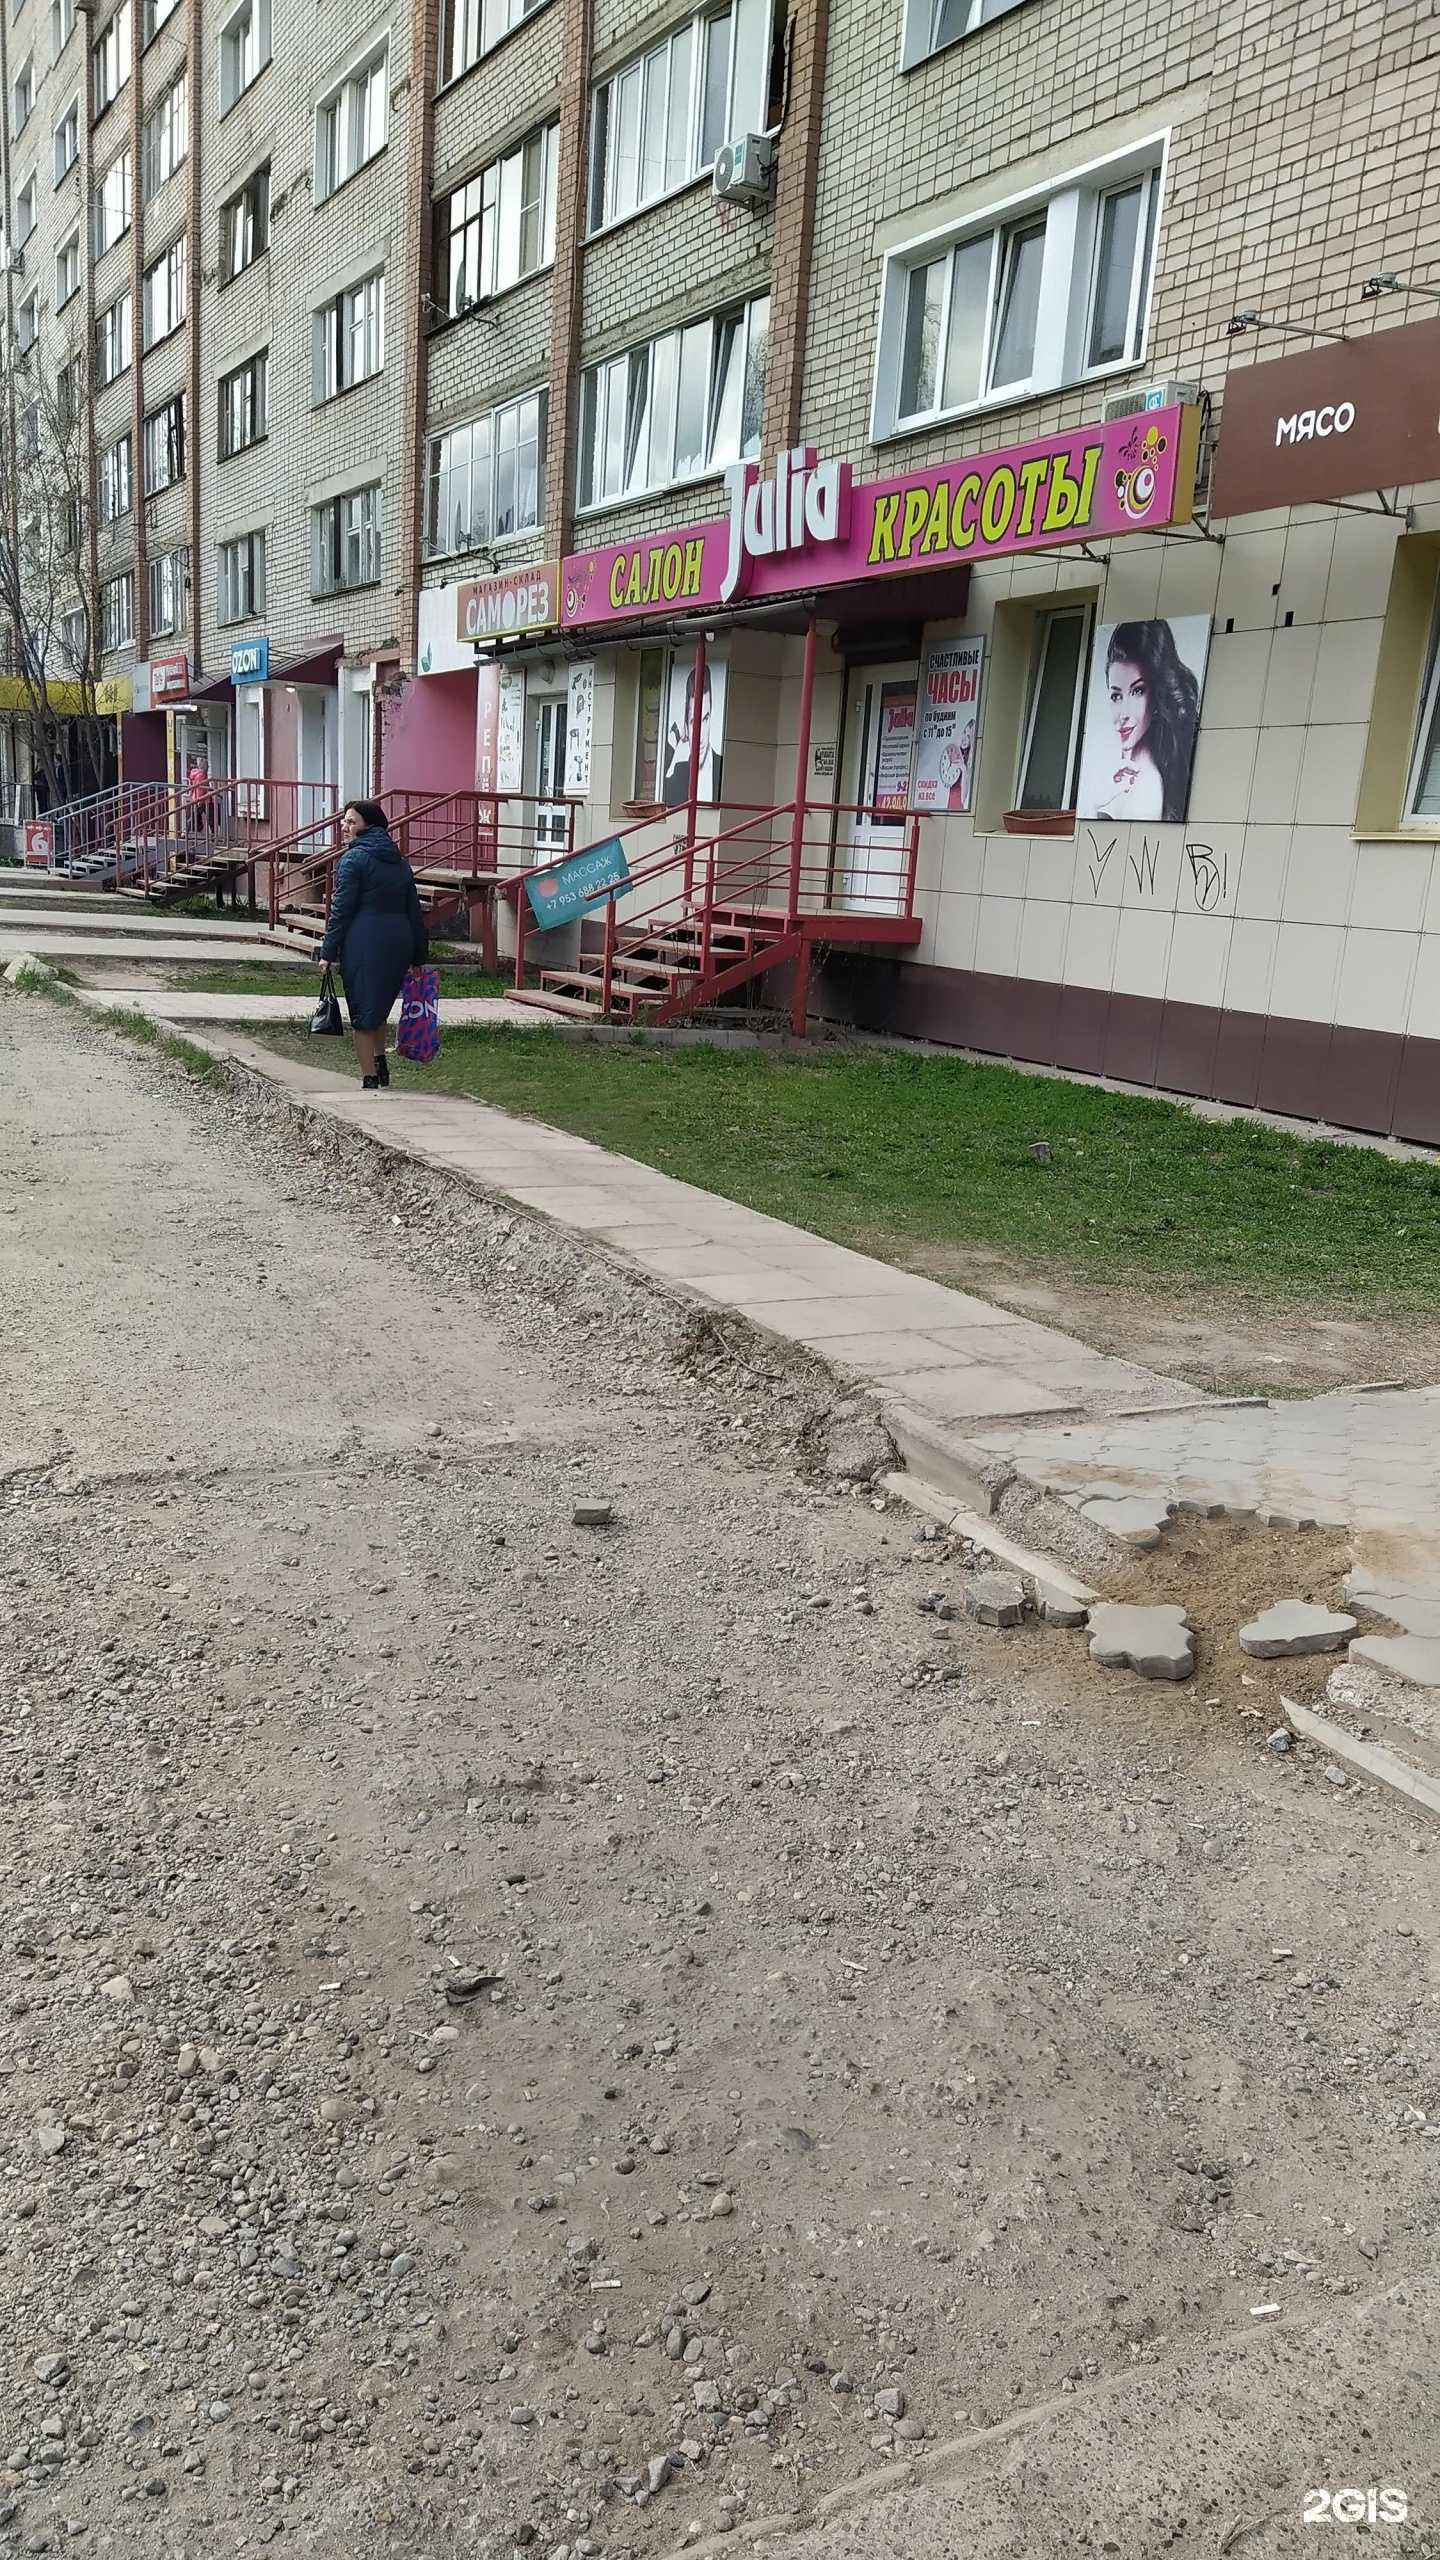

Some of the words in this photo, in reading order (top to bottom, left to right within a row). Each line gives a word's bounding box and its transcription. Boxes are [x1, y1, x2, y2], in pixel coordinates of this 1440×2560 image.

[1275, 402, 1356, 447] МЯСО
[609, 536, 705, 609] САЛОН
[720, 447, 845, 604] Julia
[867, 443, 1104, 565] КРАСОТЫ
[473, 570, 541, 595] МАГАЗИН-СКЛАД
[466, 582, 549, 635] САМОРЕЗ
[232, 648, 260, 674] OZON
[929, 649, 980, 669] СЧАСТЛИВЫЕ
[927, 669, 978, 705] ЧАСЫ
[584, 668, 594, 785] ИНСТРУМЕНТ
[925, 712, 933, 722] по
[478, 702, 493, 826] РЕПЁЖ
[562, 855, 613, 885] МАССАЖ
[558, 892, 577, 905] 953
